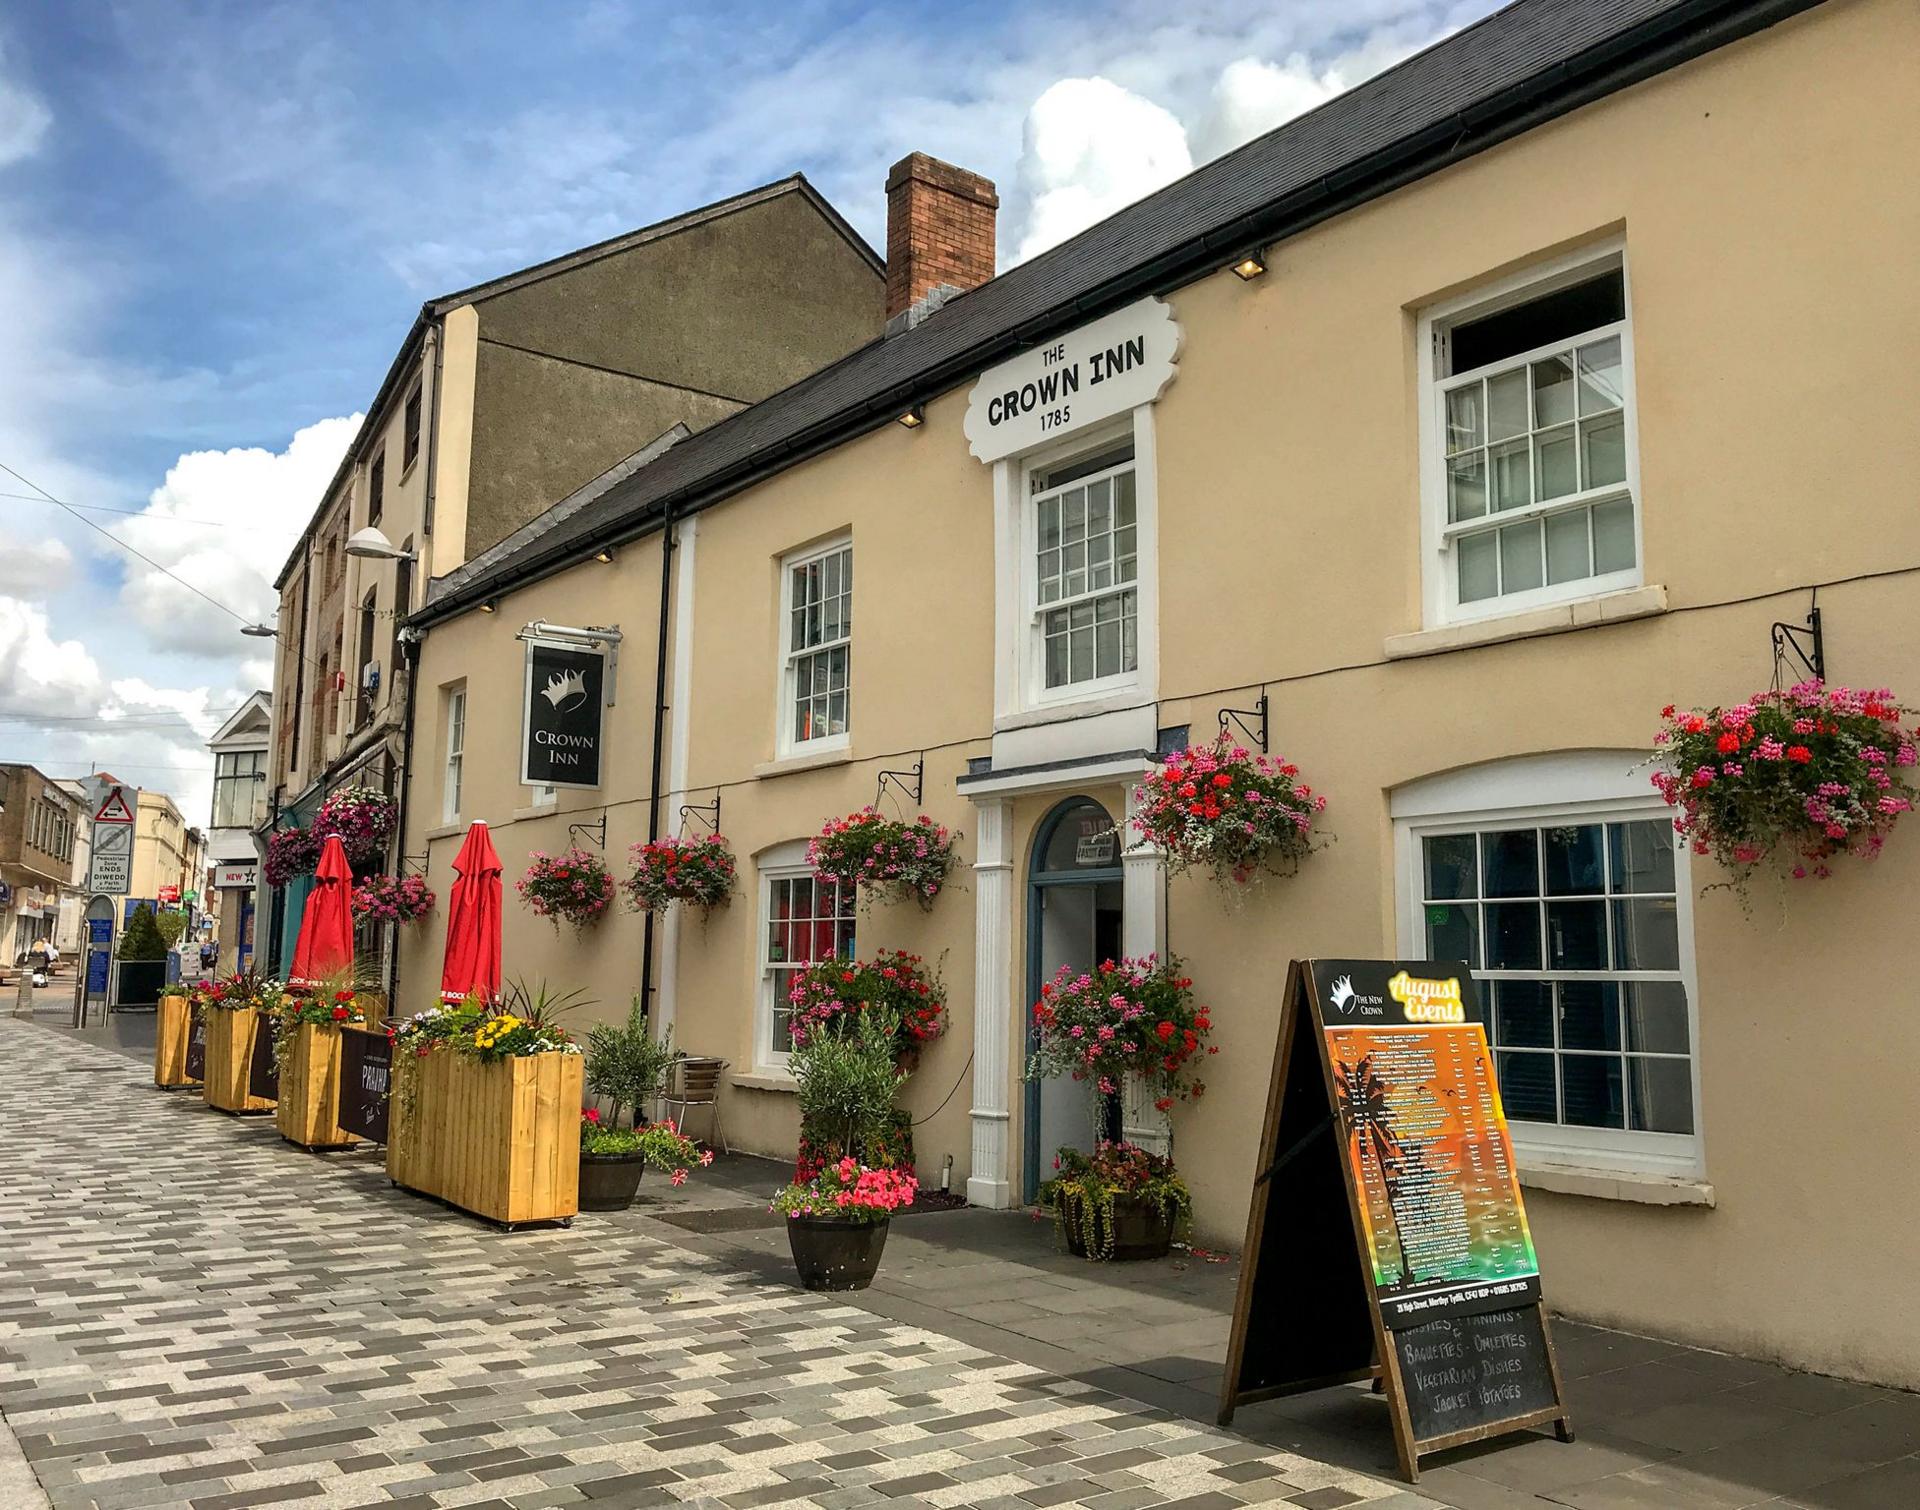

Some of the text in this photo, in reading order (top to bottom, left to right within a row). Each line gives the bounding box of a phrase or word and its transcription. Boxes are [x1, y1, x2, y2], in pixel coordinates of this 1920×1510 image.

[1043, 344, 1064, 367] THE
[988, 335, 1144, 426] CROWN INN
[1041, 405, 1070, 431] 1785
[535, 730, 594, 748] CROWN
[548, 750, 578, 765] INN
[226, 873, 243, 881] NEW
[1392, 974, 1459, 1001] August
[1360, 1005, 1383, 1015] CROWN
[1407, 998, 1464, 1021] Events
[1404, 1302, 1413, 1312] High
[1428, 1296, 1448, 1306] Merthyr
[1404, 1341, 1463, 1365] BAGUETTES
[1415, 1358, 1522, 1391] VEGETARIAN DISHES
